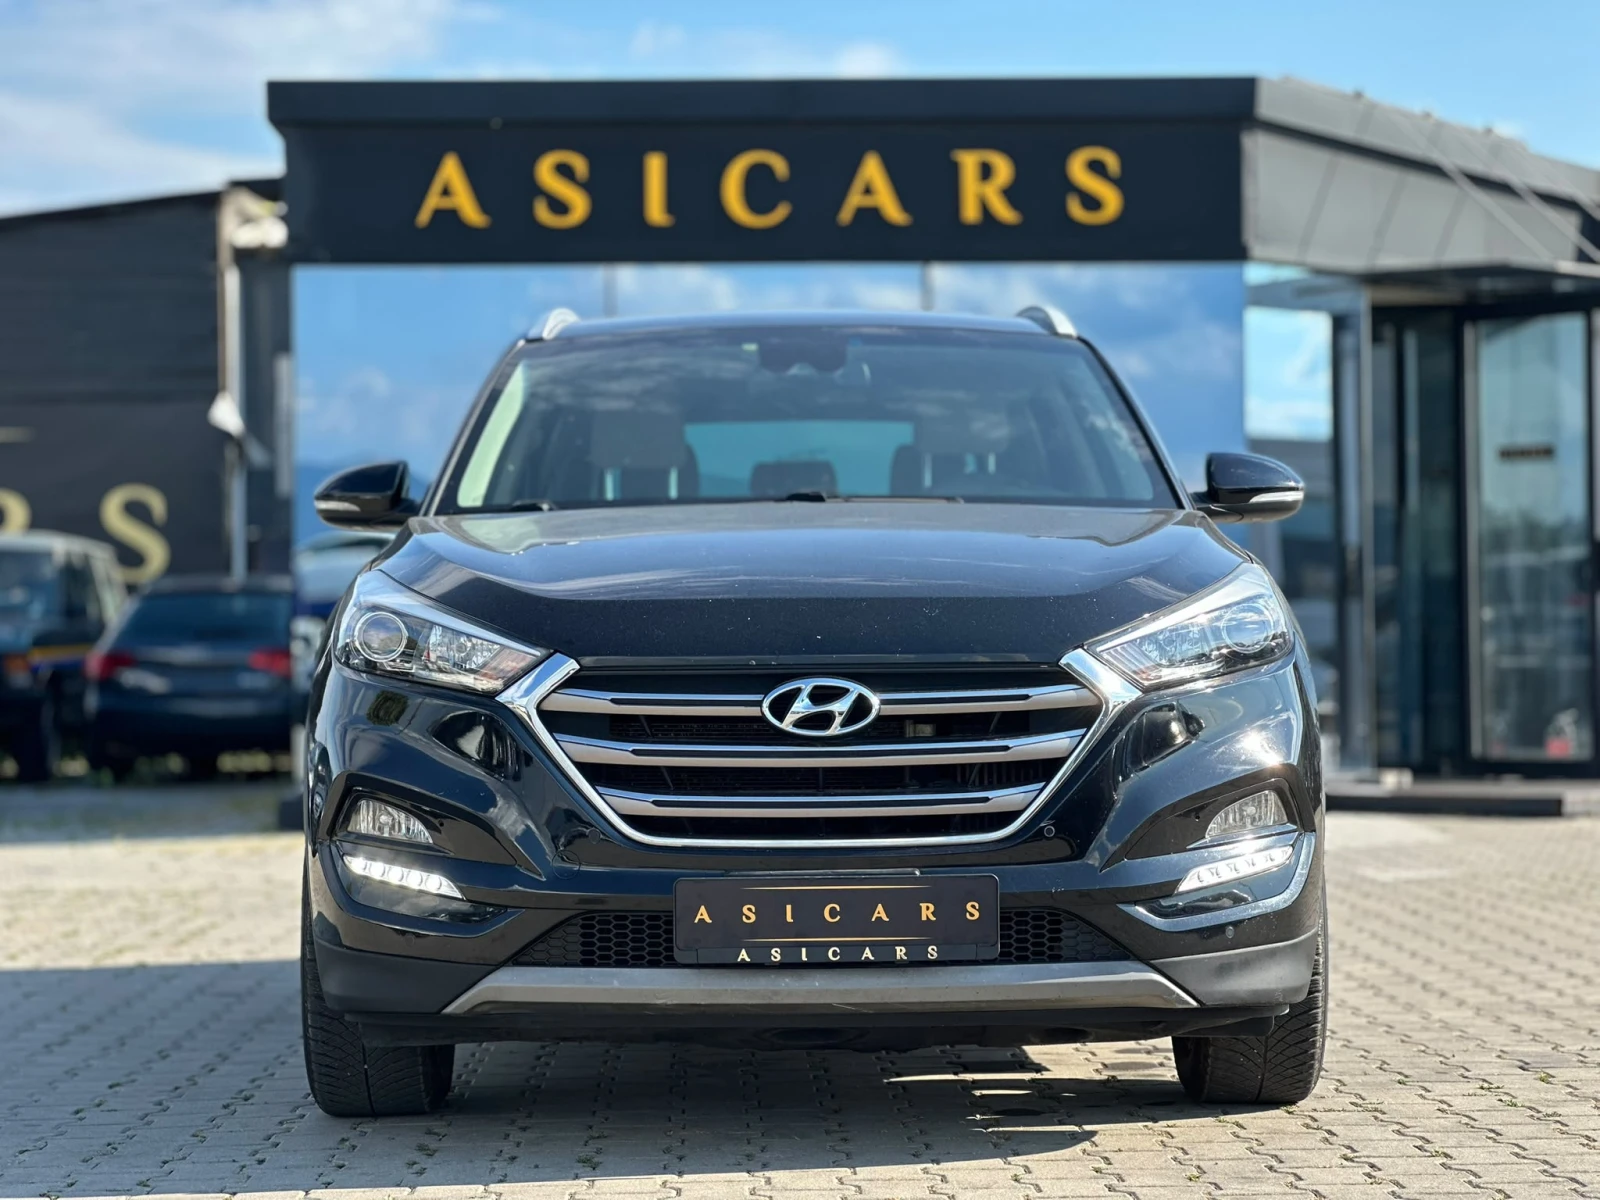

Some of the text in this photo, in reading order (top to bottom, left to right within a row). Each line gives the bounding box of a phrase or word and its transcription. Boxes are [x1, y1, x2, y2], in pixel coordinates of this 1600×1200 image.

[414, 145, 1125, 229] ASICARS
[694, 902, 980, 924] ASICARS
[737, 945, 938, 962] ASICARS
